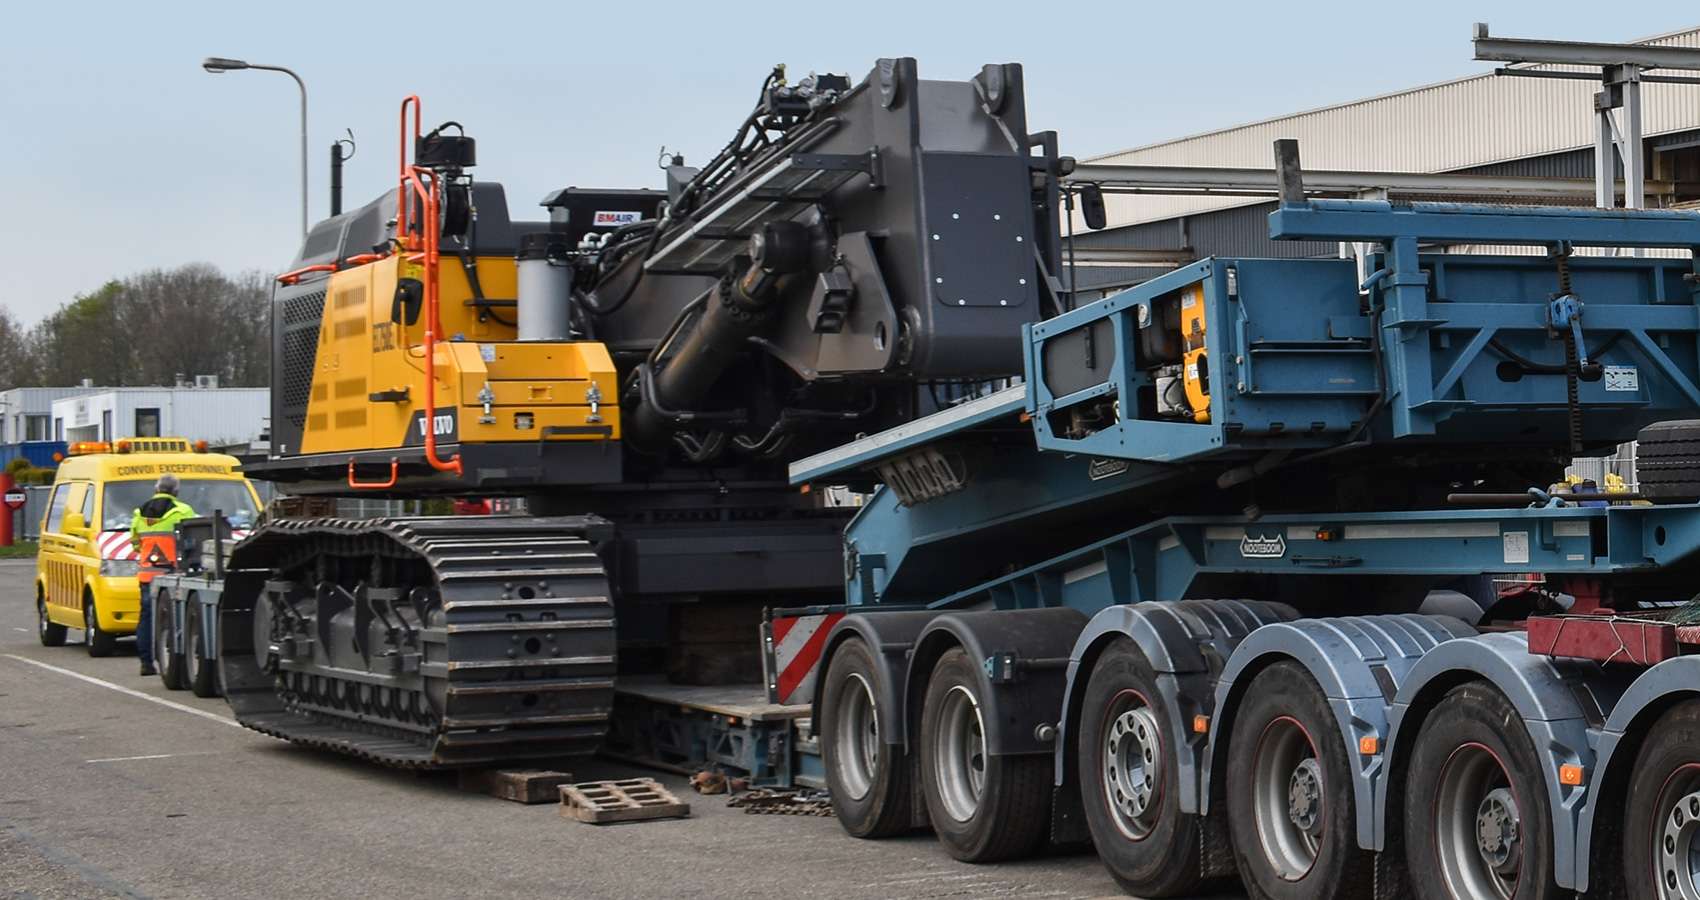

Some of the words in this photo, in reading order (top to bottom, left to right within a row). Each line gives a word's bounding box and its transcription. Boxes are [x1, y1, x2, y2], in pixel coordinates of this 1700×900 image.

[598, 213, 634, 223] BMAIR
[418, 415, 453, 436] VLVO
[118, 466, 154, 475] CONVOI
[159, 464, 230, 474] EXCEPTIONNEL
[1244, 543, 1282, 554] NOOTEBOOM
